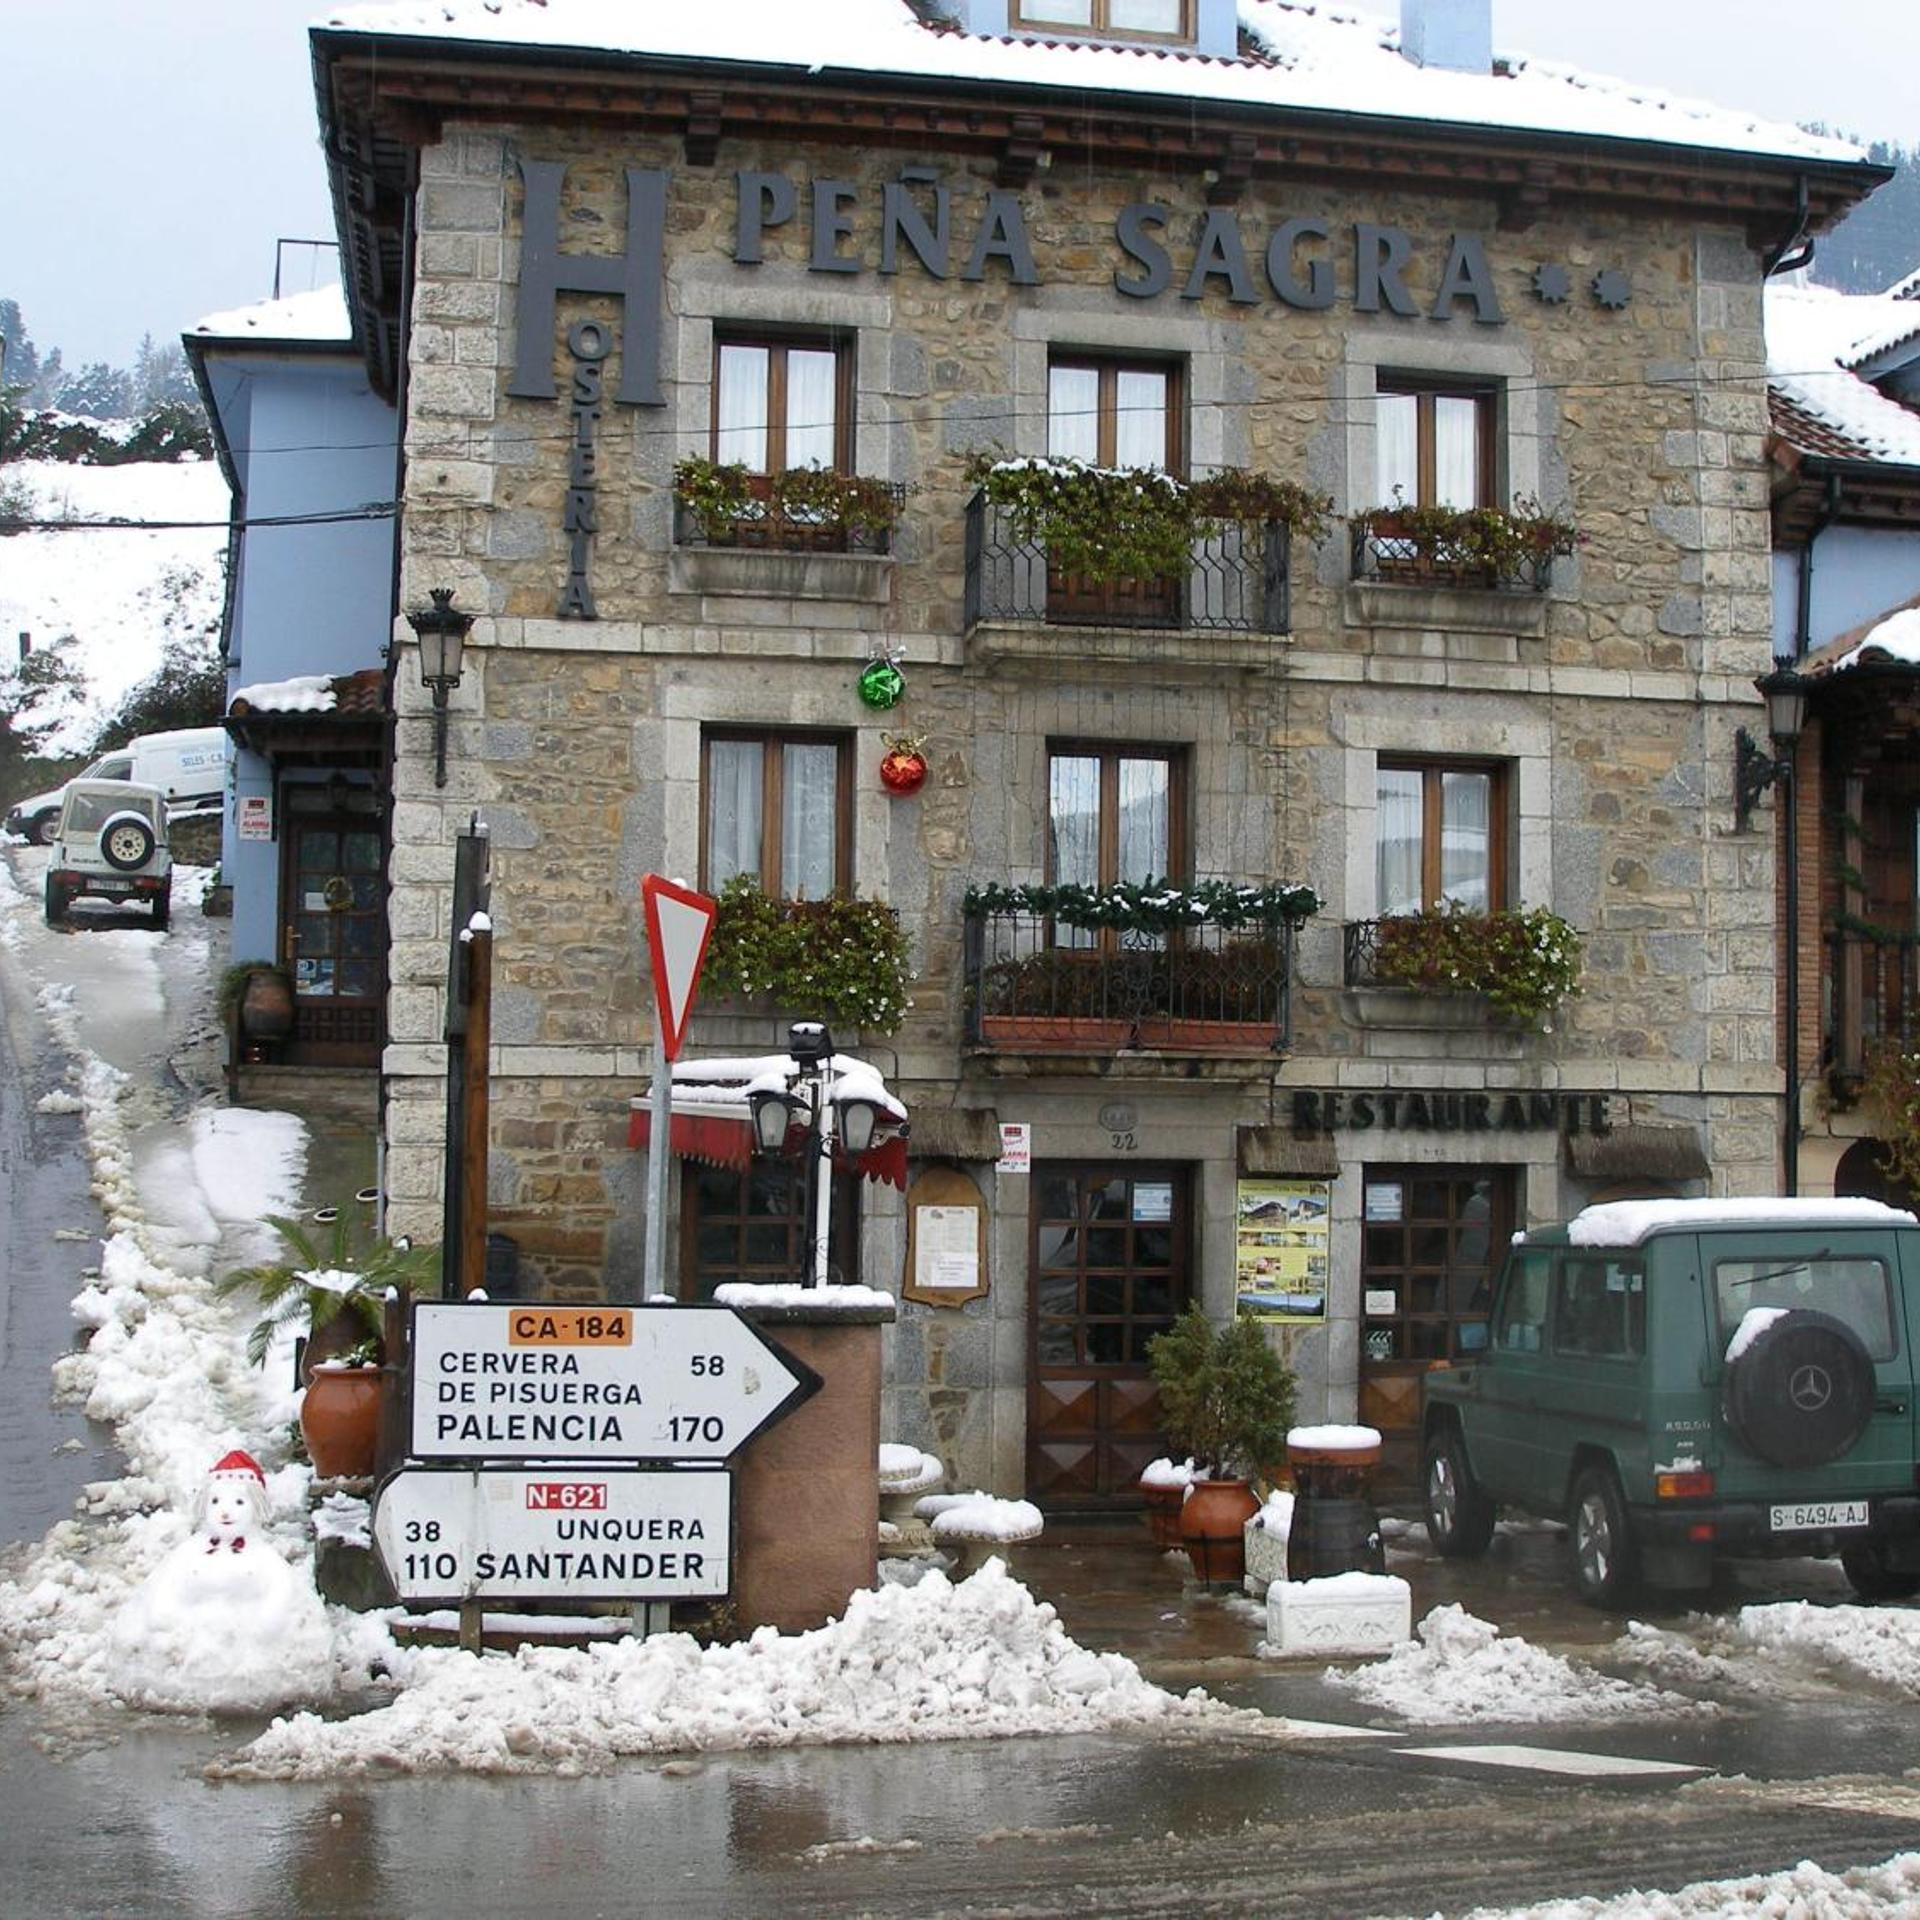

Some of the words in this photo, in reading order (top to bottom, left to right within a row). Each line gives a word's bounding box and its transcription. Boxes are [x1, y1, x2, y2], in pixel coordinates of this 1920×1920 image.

[732, 168, 1041, 285] PEÑA
[1114, 203, 1505, 324] SAGRA
[1292, 1090, 1613, 1137] RESTAURANTE
[1111, 1132, 1138, 1151] 22
[439, 1351, 580, 1376] CERVERA
[690, 1355, 725, 1377] 58
[438, 1381, 477, 1403] DE
[489, 1382, 643, 1406] PISUERGA
[437, 1413, 623, 1442] PALENCIA
[669, 1416, 725, 1443] 170
[527, 1486, 608, 1510] N-621
[404, 1521, 441, 1543] 38
[556, 1518, 705, 1541] UNQUERA
[404, 1553, 457, 1581] 110
[475, 1552, 705, 1580] SANTANDER
